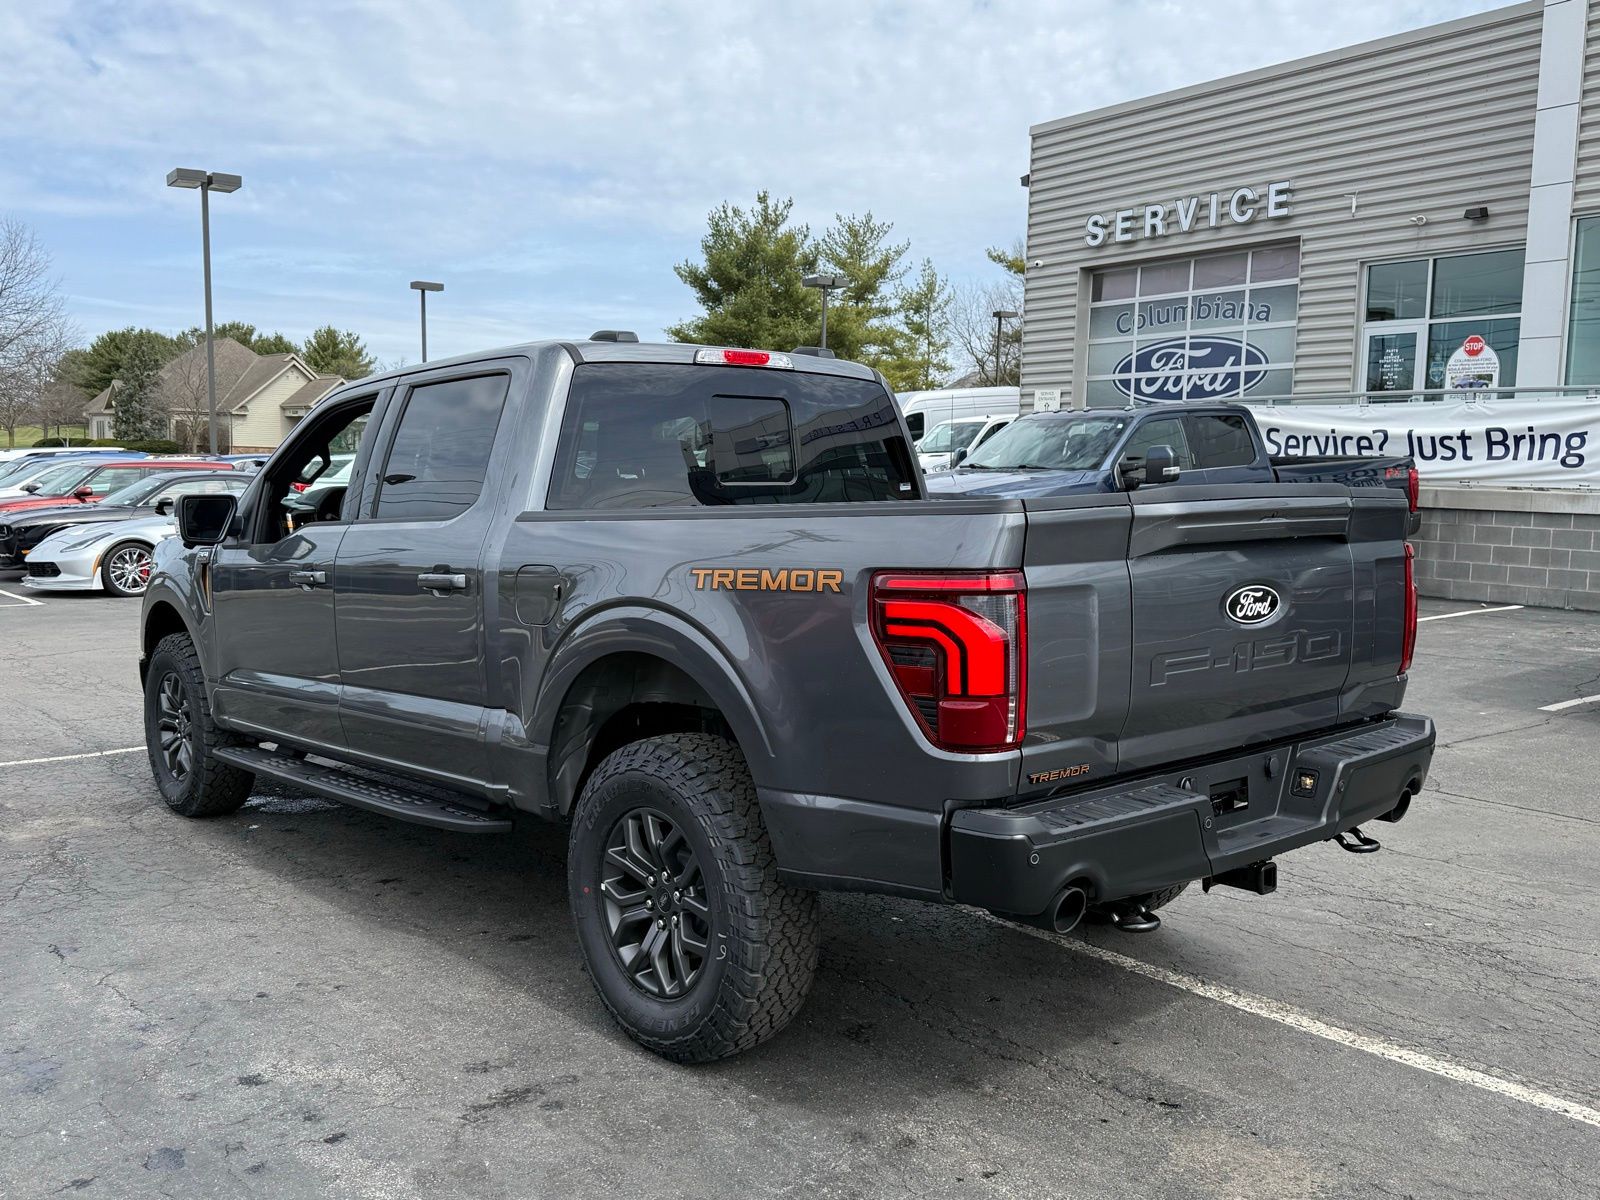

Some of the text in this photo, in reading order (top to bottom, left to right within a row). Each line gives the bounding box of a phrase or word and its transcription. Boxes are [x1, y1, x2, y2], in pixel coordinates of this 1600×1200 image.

[1085, 179, 1292, 247] SERVICE
[1116, 296, 1271, 334] Columbiana
[1465, 342, 1483, 351] STOP
[1140, 347, 1235, 394] Ford
[1265, 426, 1588, 468] Service? Just Bring
[690, 568, 844, 593] TREMOR
[1236, 590, 1272, 618] Ford
[1149, 629, 1342, 687] F-150
[1030, 763, 1090, 784] TREMOR
